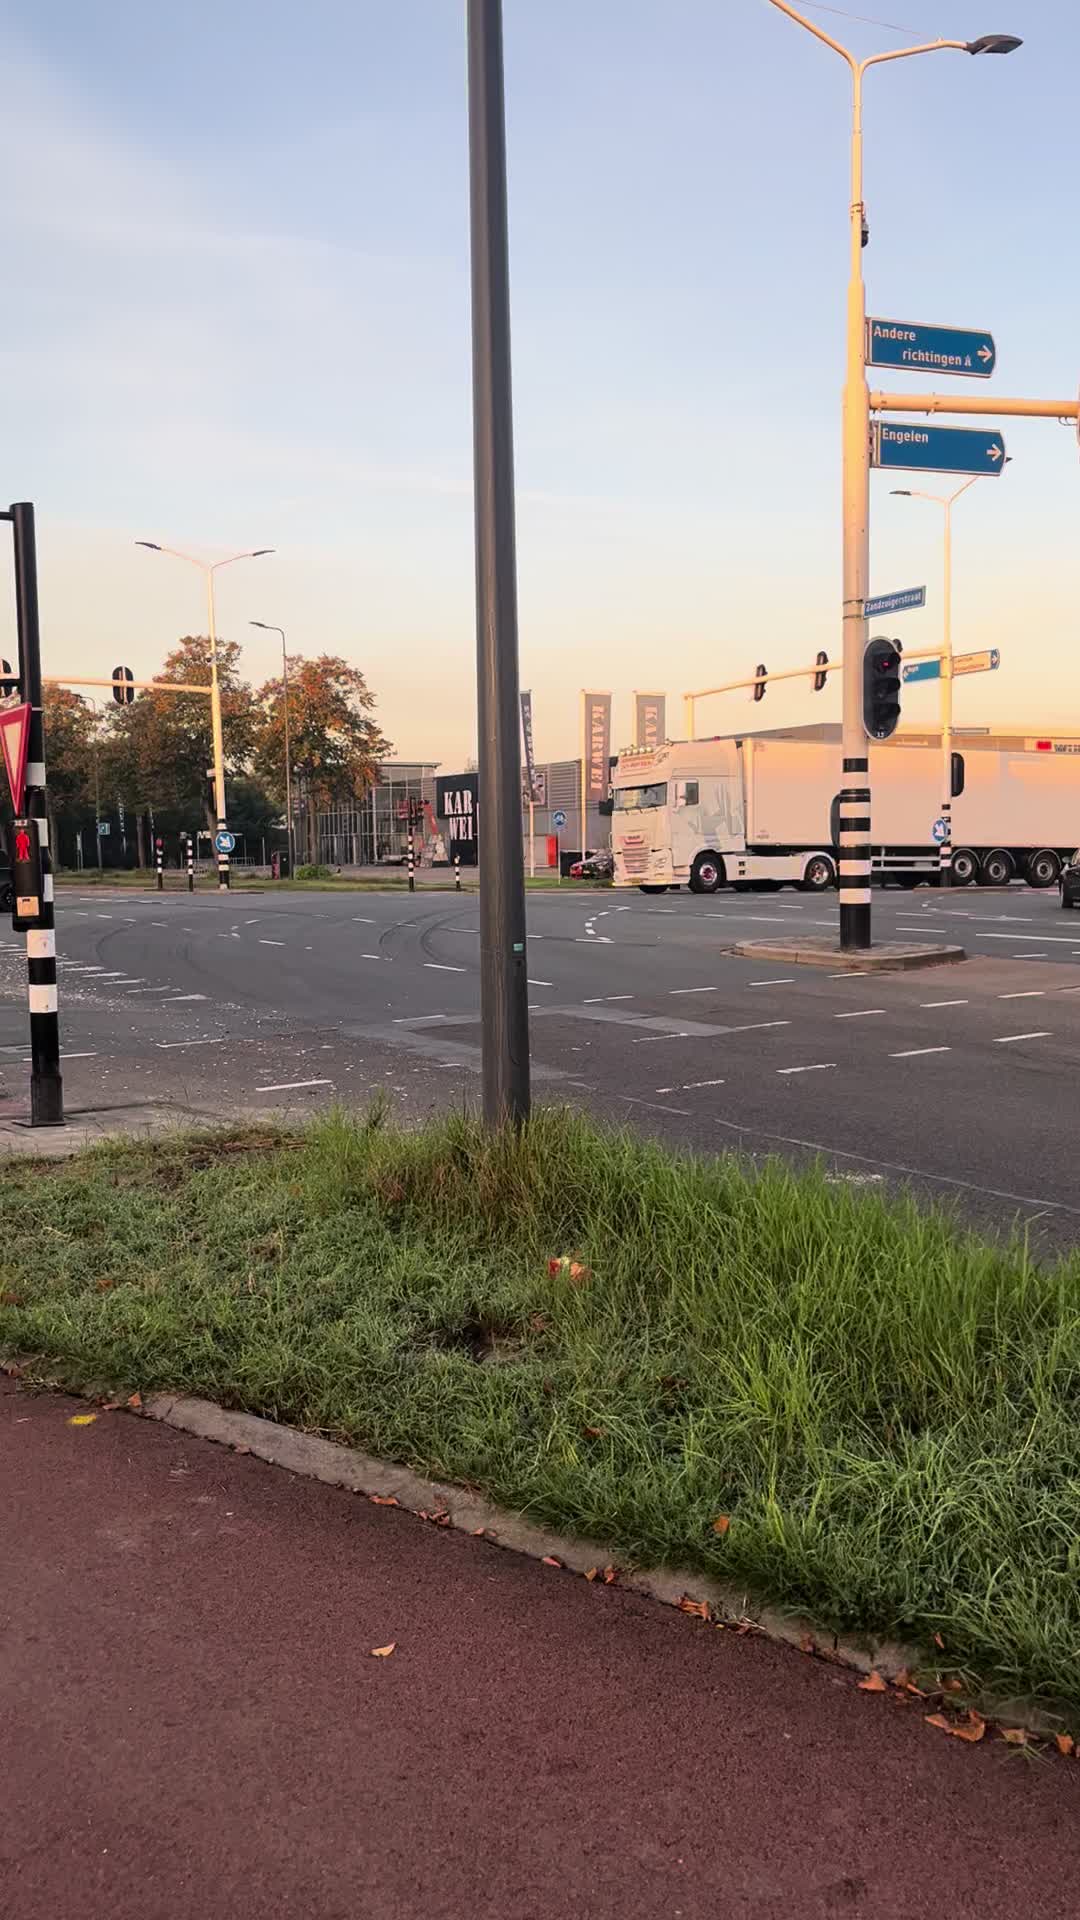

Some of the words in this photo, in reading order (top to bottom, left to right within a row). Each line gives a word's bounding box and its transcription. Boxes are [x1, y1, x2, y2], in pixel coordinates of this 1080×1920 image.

[874, 325, 917, 342] Andere
[902, 347, 962, 368] richtingen
[882, 427, 929, 445] Engelen
[591, 705, 605, 790] KARWEI
[444, 790, 473, 815] KAR
[449, 816, 473, 841] WEI
